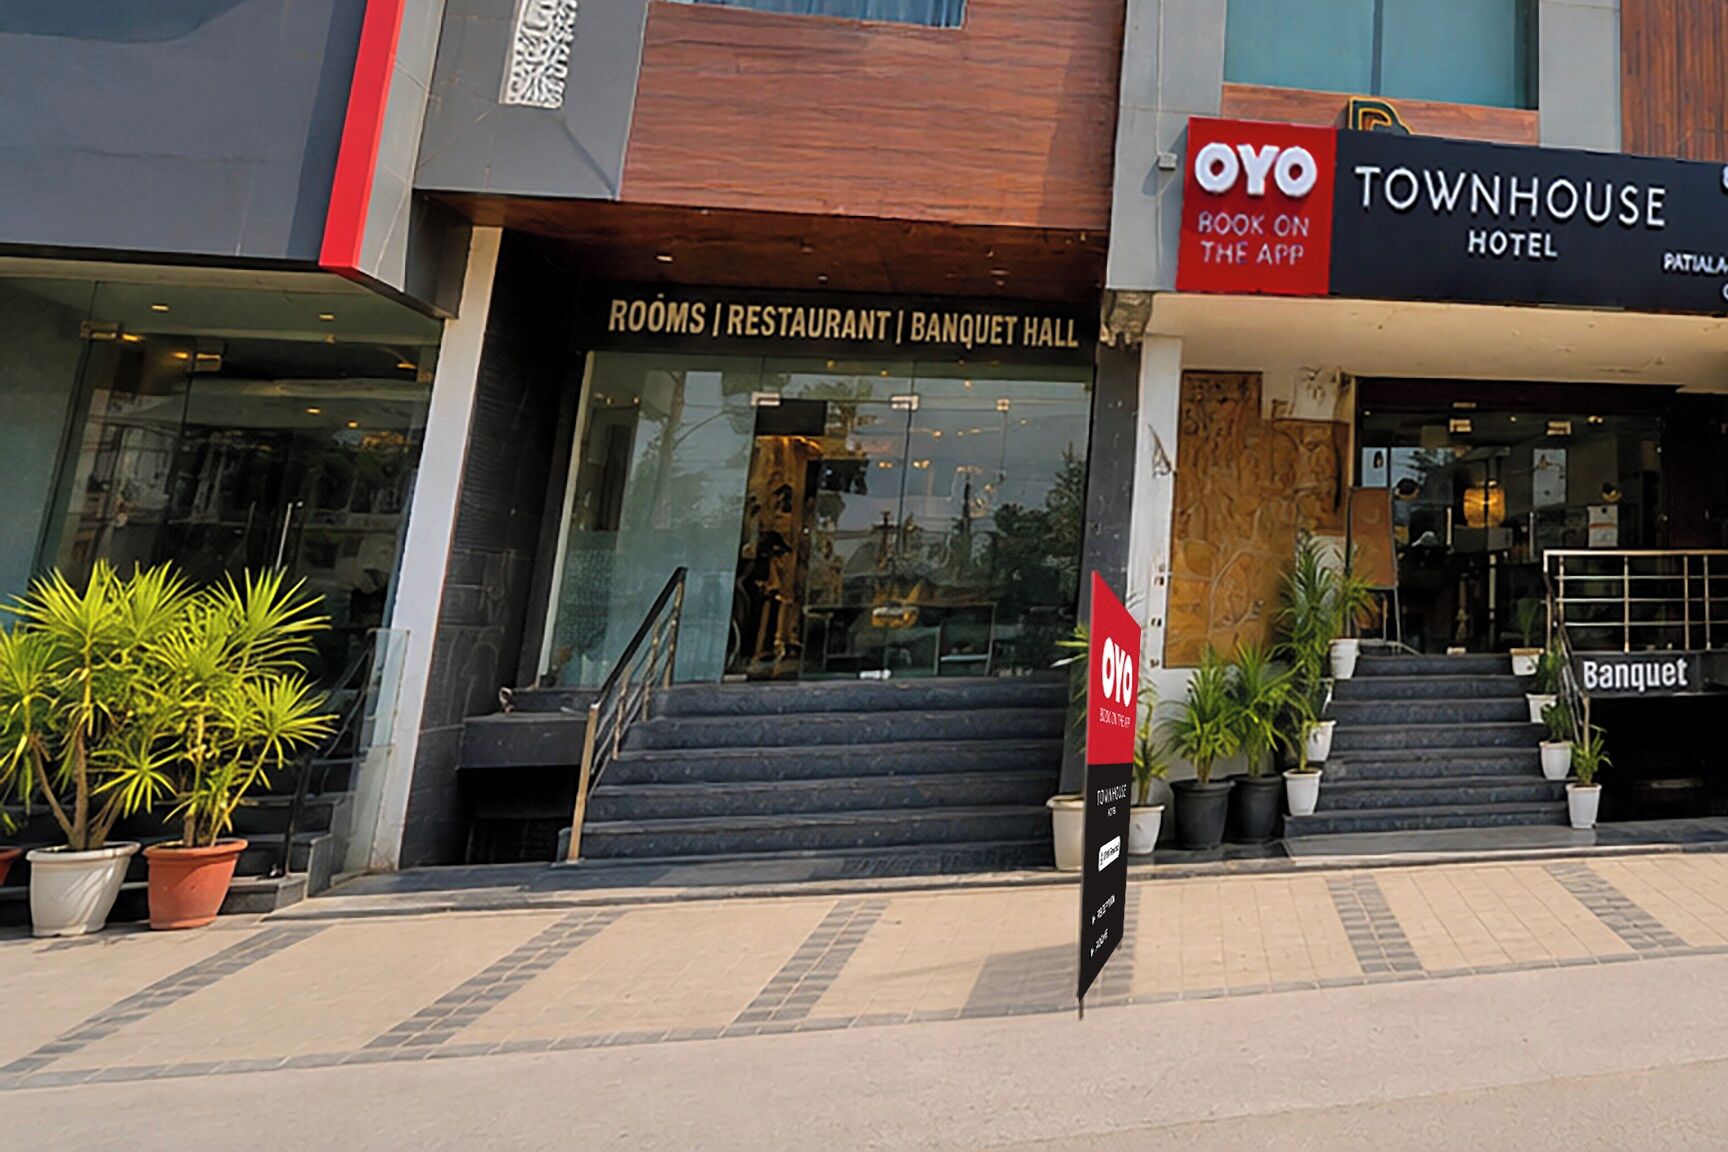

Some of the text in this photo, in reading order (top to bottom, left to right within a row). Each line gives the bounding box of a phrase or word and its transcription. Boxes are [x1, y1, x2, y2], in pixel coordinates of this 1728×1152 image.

[1194, 142, 1318, 198] OYO
[1354, 165, 1666, 227] TOWNHOUSE
[1198, 211, 1310, 237] BOOK ON
[1467, 230, 1558, 258] HOTEL
[1200, 241, 1305, 266] THE APP
[608, 299, 706, 334] ROOMS
[727, 304, 892, 339] RESTAURANT
[910, 311, 1018, 349] BANQUET
[1023, 316, 1079, 347] HALL
[1101, 636, 1133, 708] OYO
[1583, 658, 1688, 692] Banquet
